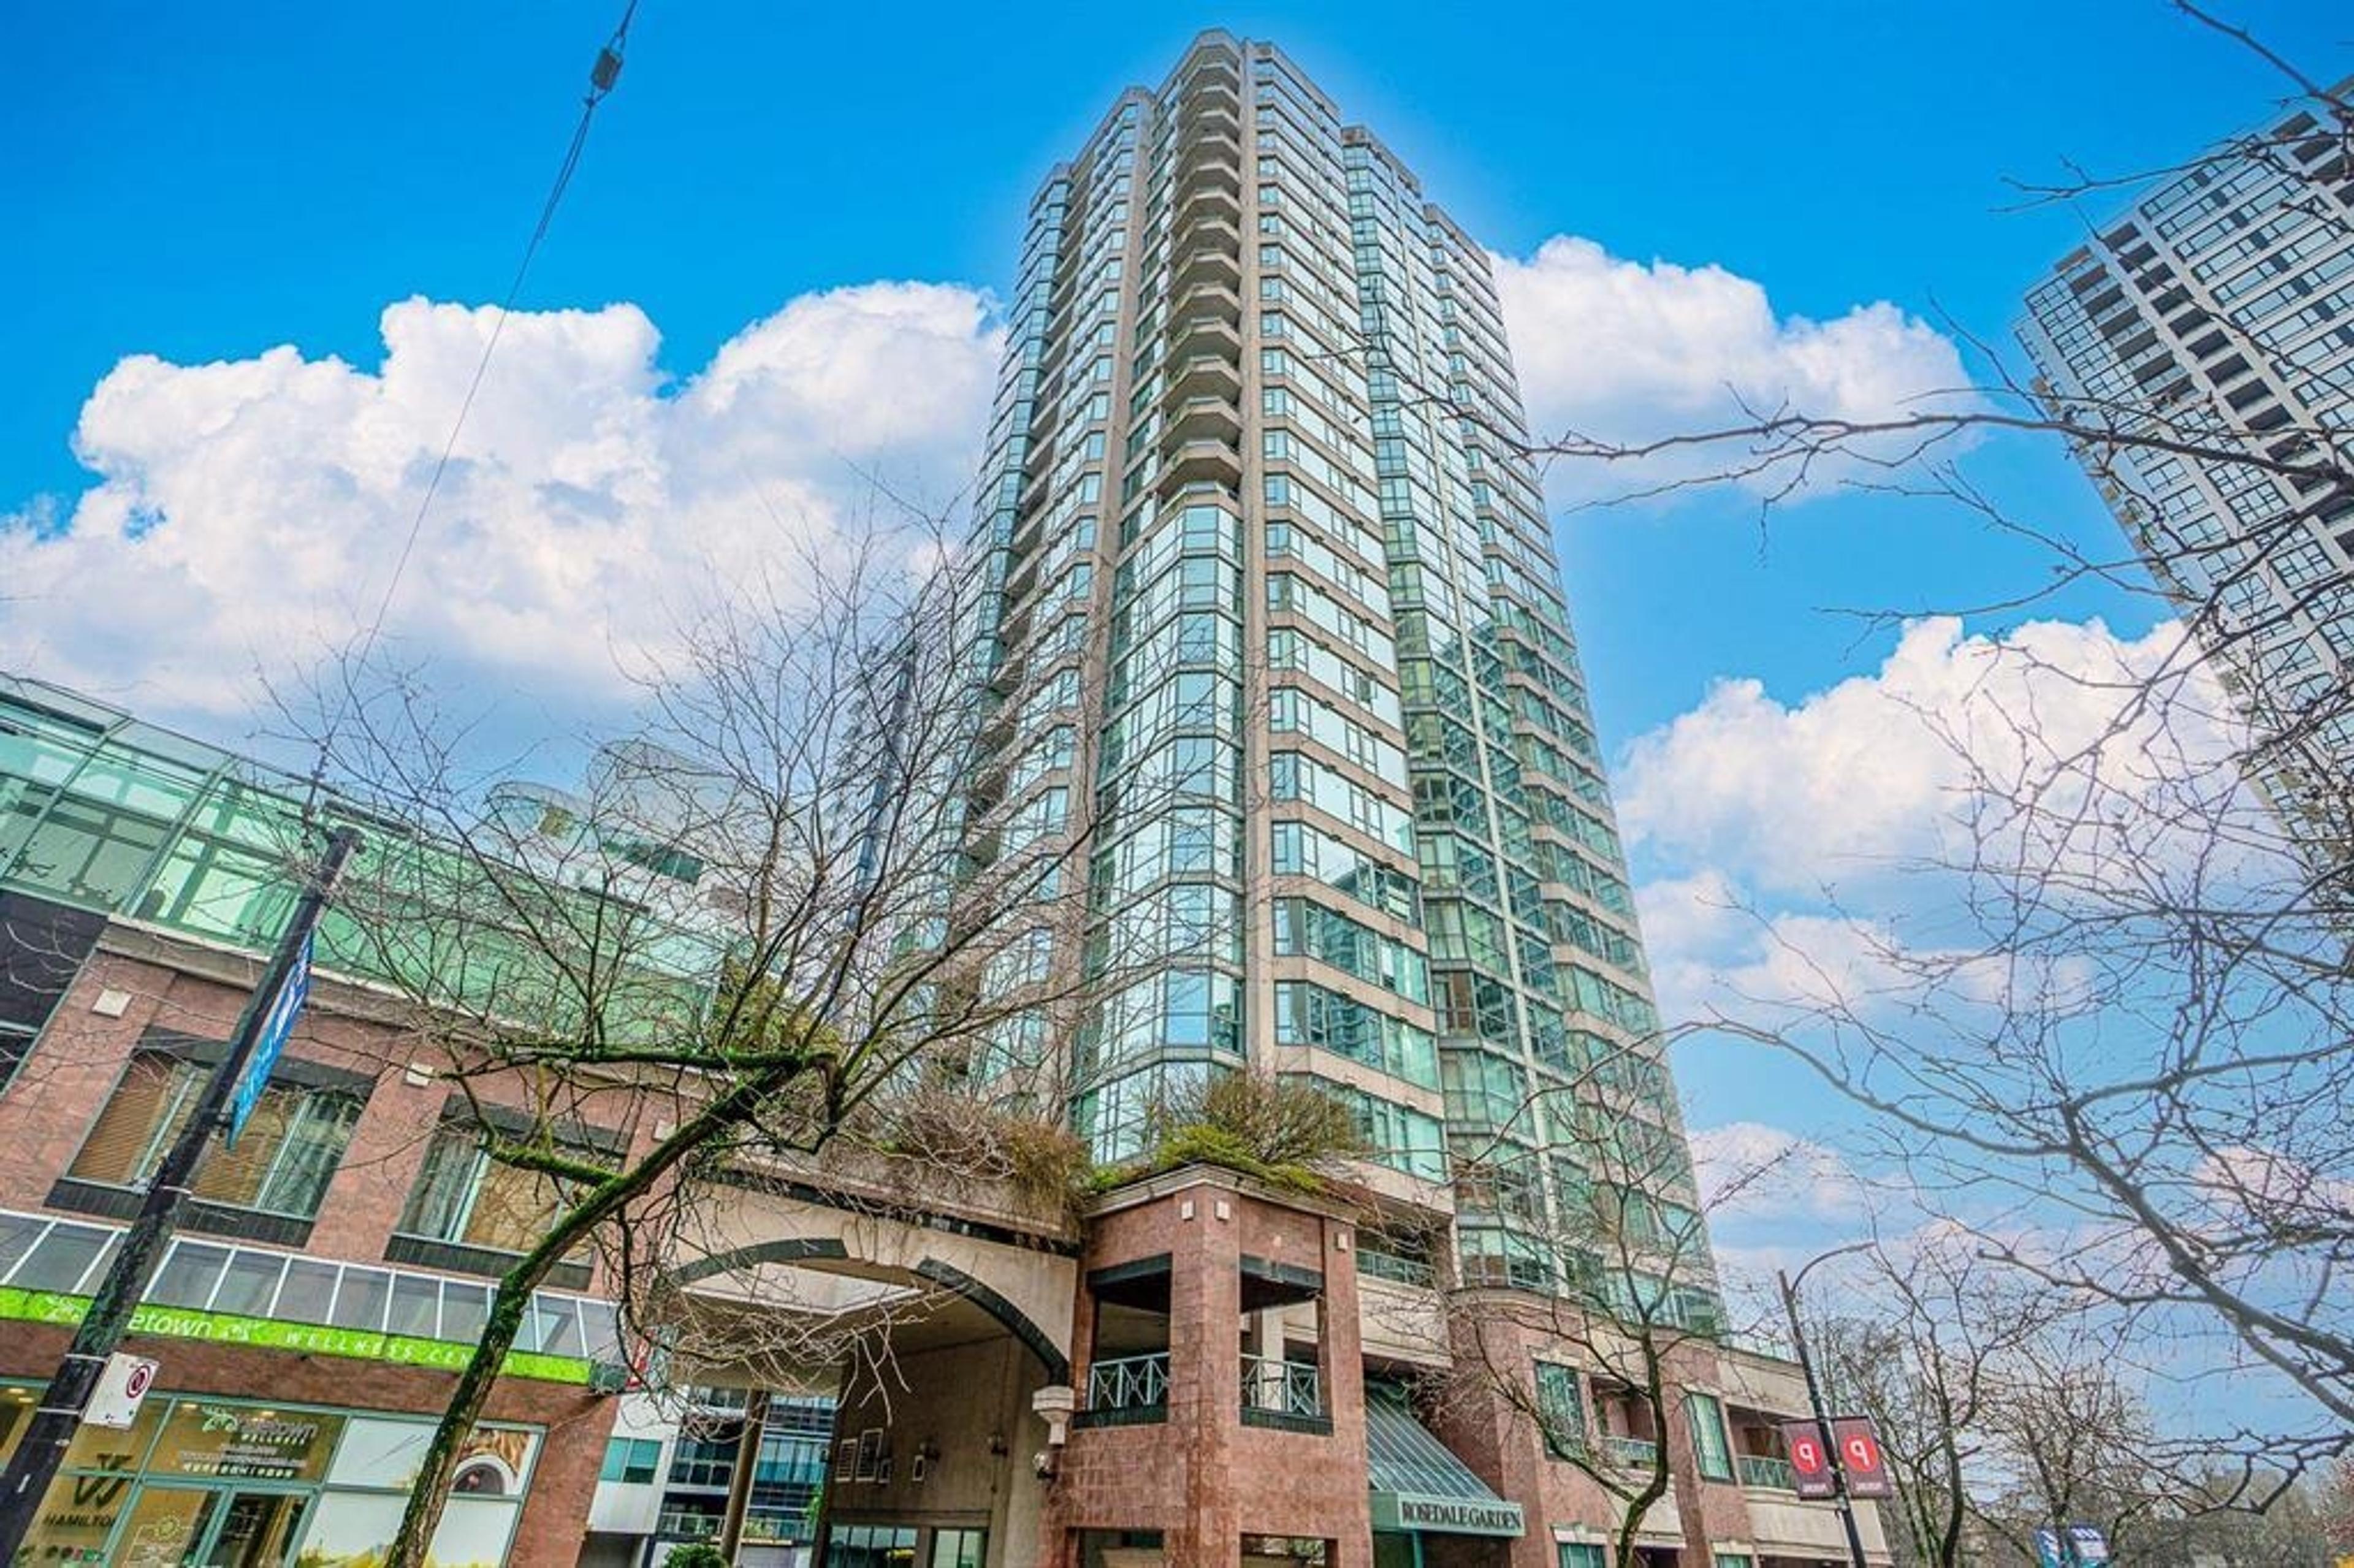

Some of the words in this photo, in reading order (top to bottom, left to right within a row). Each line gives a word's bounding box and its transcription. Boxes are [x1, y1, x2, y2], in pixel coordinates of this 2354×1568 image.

[286, 1332, 413, 1357] WELLNESS
[1402, 1501, 1468, 1526] ROSEDALE
[1469, 1507, 1520, 1529] GARDEN
